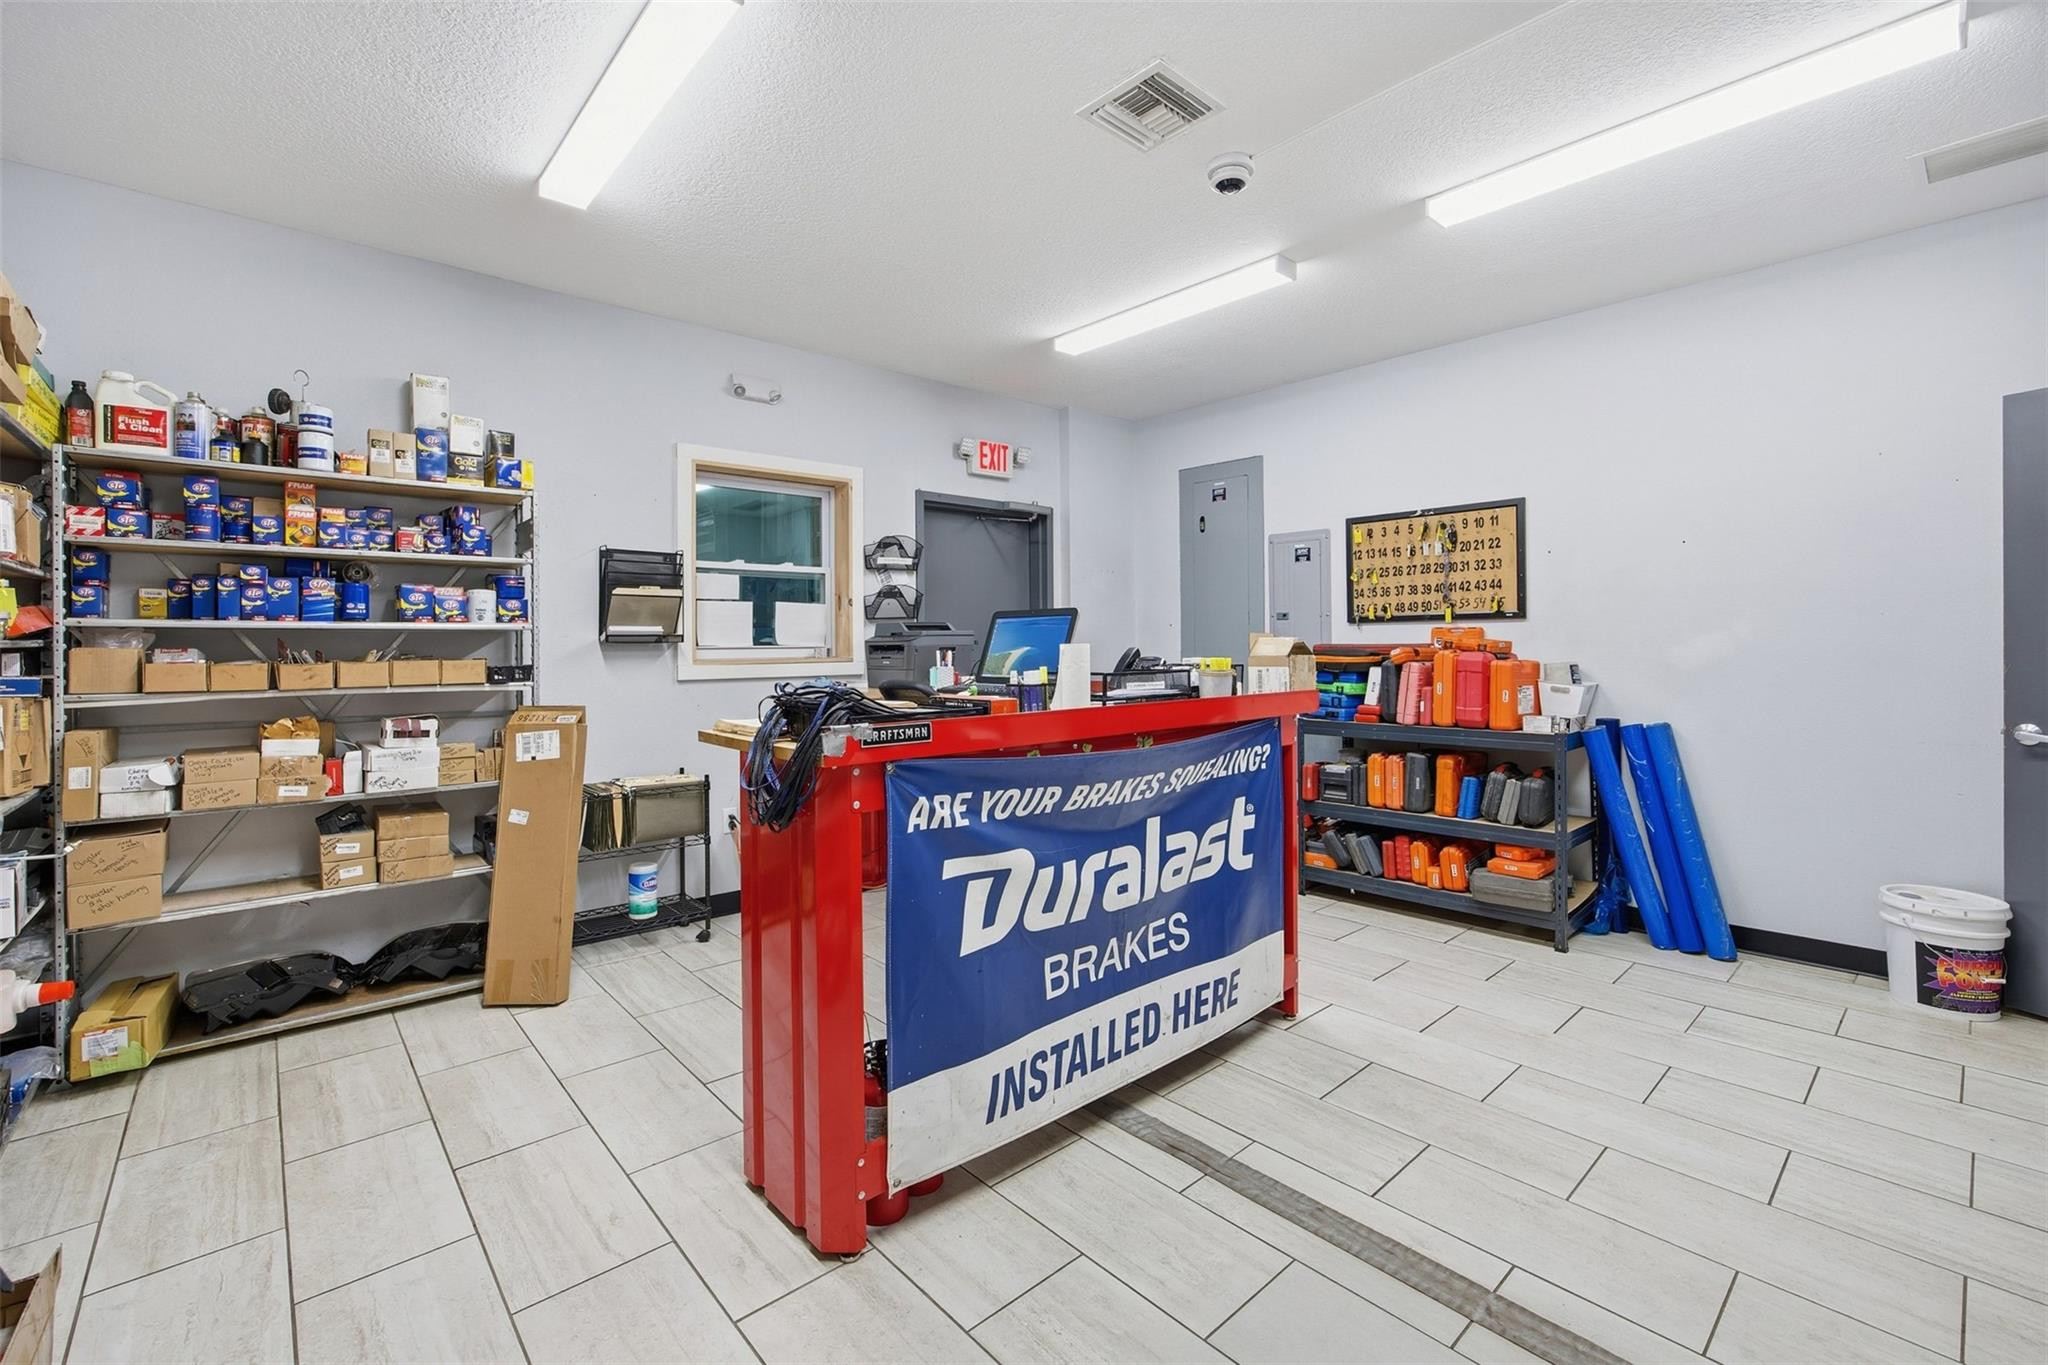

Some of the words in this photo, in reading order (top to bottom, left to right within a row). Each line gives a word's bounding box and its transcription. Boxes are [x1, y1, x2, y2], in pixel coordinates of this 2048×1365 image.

[118, 416, 150, 426] Flush
[118, 422, 126, 430] &
[130, 422, 163, 434] Clean
[454, 455, 477, 467] Gold
[980, 441, 1008, 472] EXIT
[288, 482, 315, 490] FRAM
[288, 510, 315, 518] FRAM
[1381, 526, 1387, 538] 3
[1394, 526, 1400, 536] 4
[1408, 524, 1414, 534] 5
[1462, 518, 1468, 529] 9
[1474, 517, 1484, 528] 10
[1490, 515, 1500, 526] 11
[1354, 550, 1362, 560] 12
[1365, 548, 1376, 559] 13
[1378, 548, 1388, 558] 14
[1392, 546, 1401, 558] 15
[1460, 541, 1472, 552] 20
[1474, 540, 1485, 550] 21
[1488, 538, 1502, 549] 22
[1379, 567, 1390, 578] 25
[1392, 566, 1404, 576] 26
[1406, 564, 1417, 576] 27
[1420, 563, 1432, 574] 28
[1433, 562, 1444, 573] 29
[1460, 560, 1470, 572] 31
[1474, 559, 1486, 570] 32
[1489, 558, 1502, 570] 33
[310, 579, 330, 590] STP
[1354, 588, 1364, 599] 34
[1380, 586, 1391, 598] 36
[1394, 586, 1404, 596] 37
[1408, 584, 1418, 596] 38
[1420, 584, 1432, 594] 39
[1434, 582, 1444, 594] 40
[1459, 580, 1472, 592] 42
[1474, 580, 1488, 591] 43
[1488, 578, 1502, 590] 44
[1394, 602, 1406, 613] 48
[1407, 602, 1418, 612] 49
[1421, 600, 1432, 612] 50
[1460, 598, 1471, 609] 53
[1473, 597, 1486, 610] 54
[866, 726, 928, 742] RAFTSMAN
[907, 792, 972, 834] ARE
[981, 786, 1062, 820] YOUR
[1063, 771, 1166, 813] BRAKES
[1164, 743, 1271, 794] SQUEALING?
[942, 796, 1256, 958] Duralast
[1044, 912, 1191, 1001] BRAKES
[985, 1002, 1161, 1125] INSTALLED
[1172, 968, 1241, 1035] HERE
